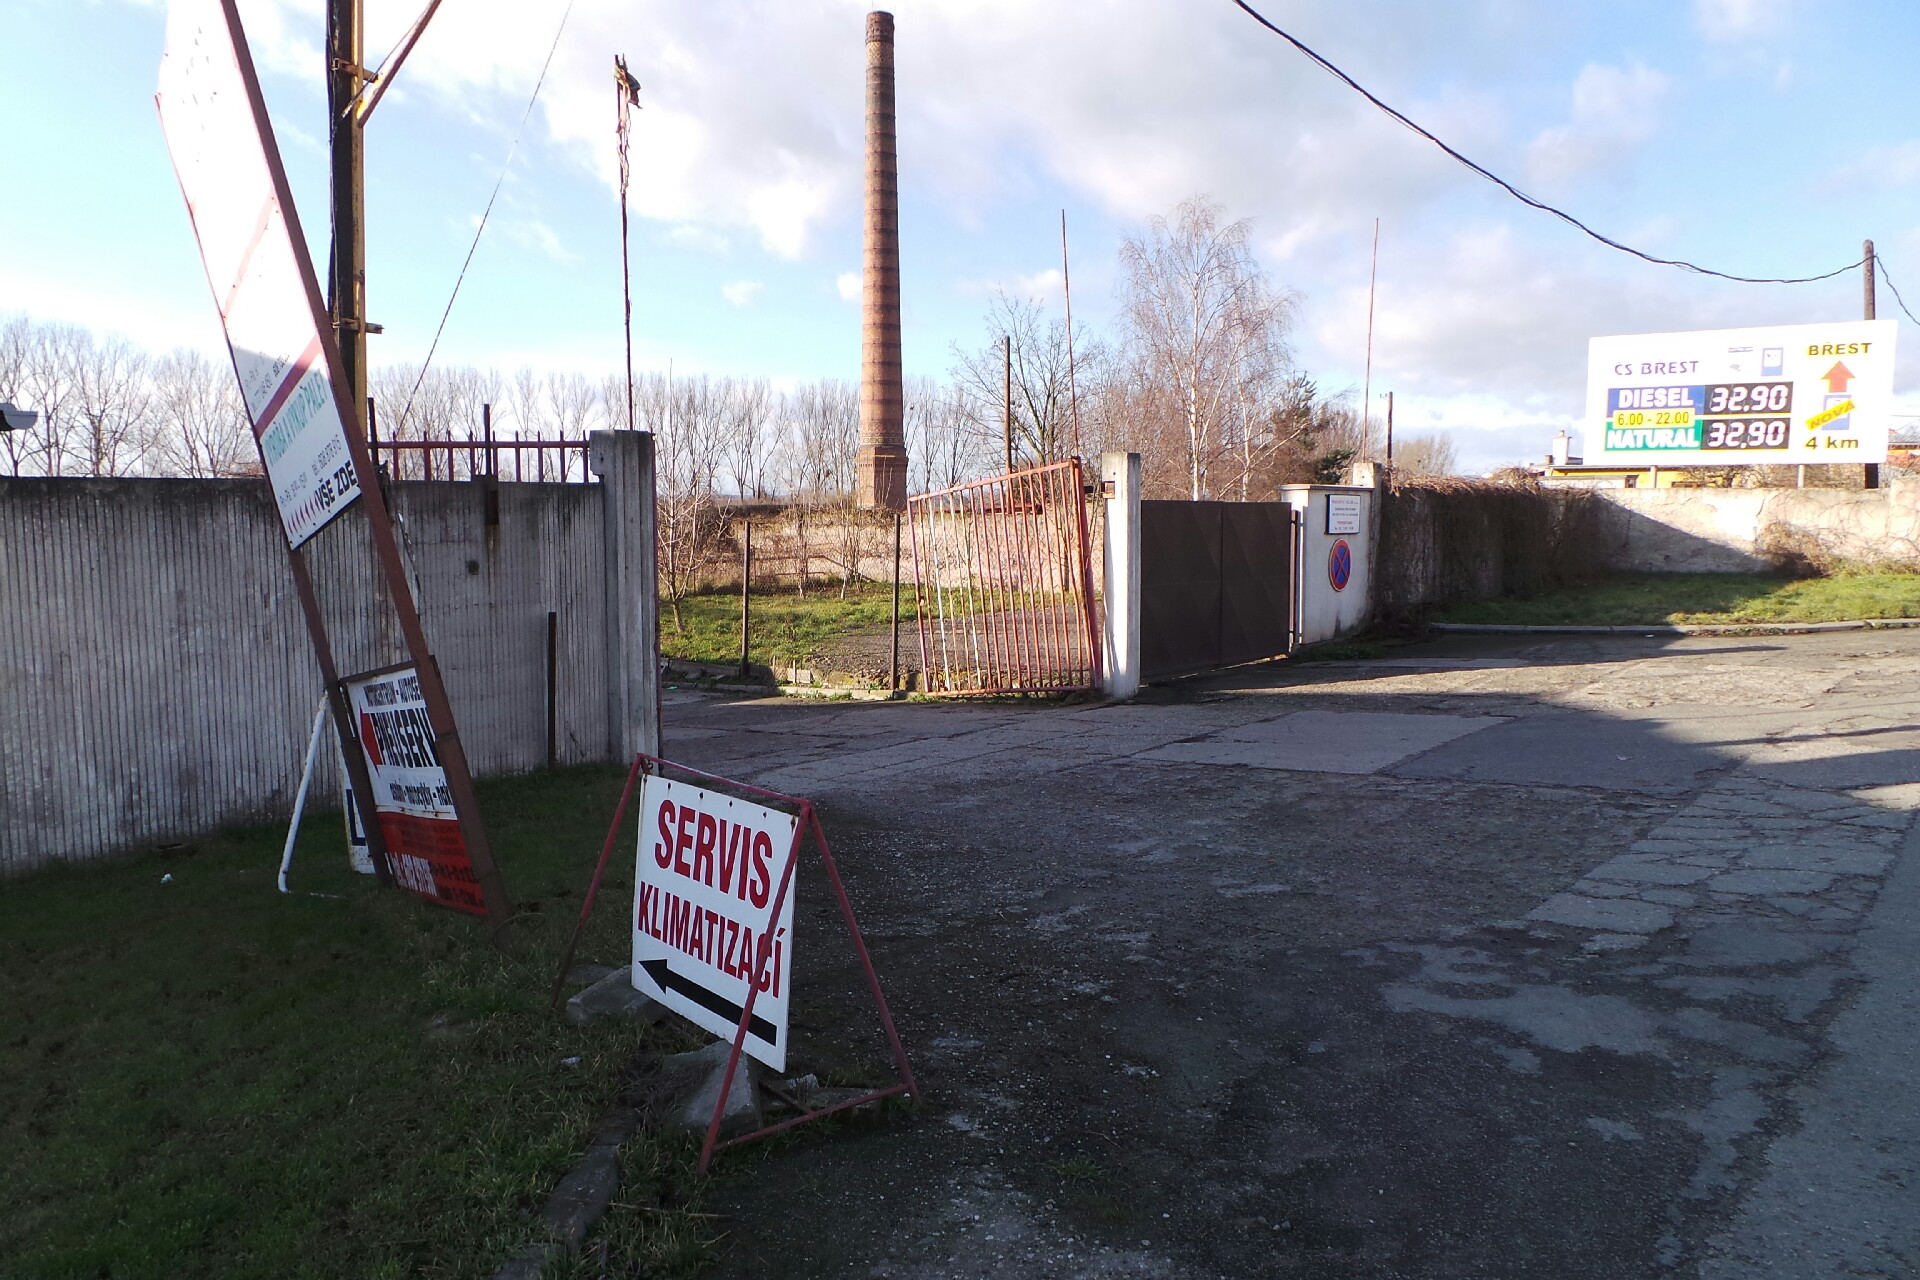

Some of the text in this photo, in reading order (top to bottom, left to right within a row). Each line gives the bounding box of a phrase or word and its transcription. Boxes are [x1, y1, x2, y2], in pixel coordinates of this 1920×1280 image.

[1618, 387, 1694, 408] DIESEL
[1710, 384, 1789, 413] 32.90
[1617, 412, 1644, 426] 6.00
[1655, 411, 1689, 425] 22.00
[1606, 428, 1699, 449] NATURAL
[1707, 420, 1787, 449] 32.90
[1805, 436, 1859, 450] 4 km
[315, 478, 336, 510] VŠE
[333, 460, 358, 496] ZDE
[654, 798, 773, 910] SERVIS
